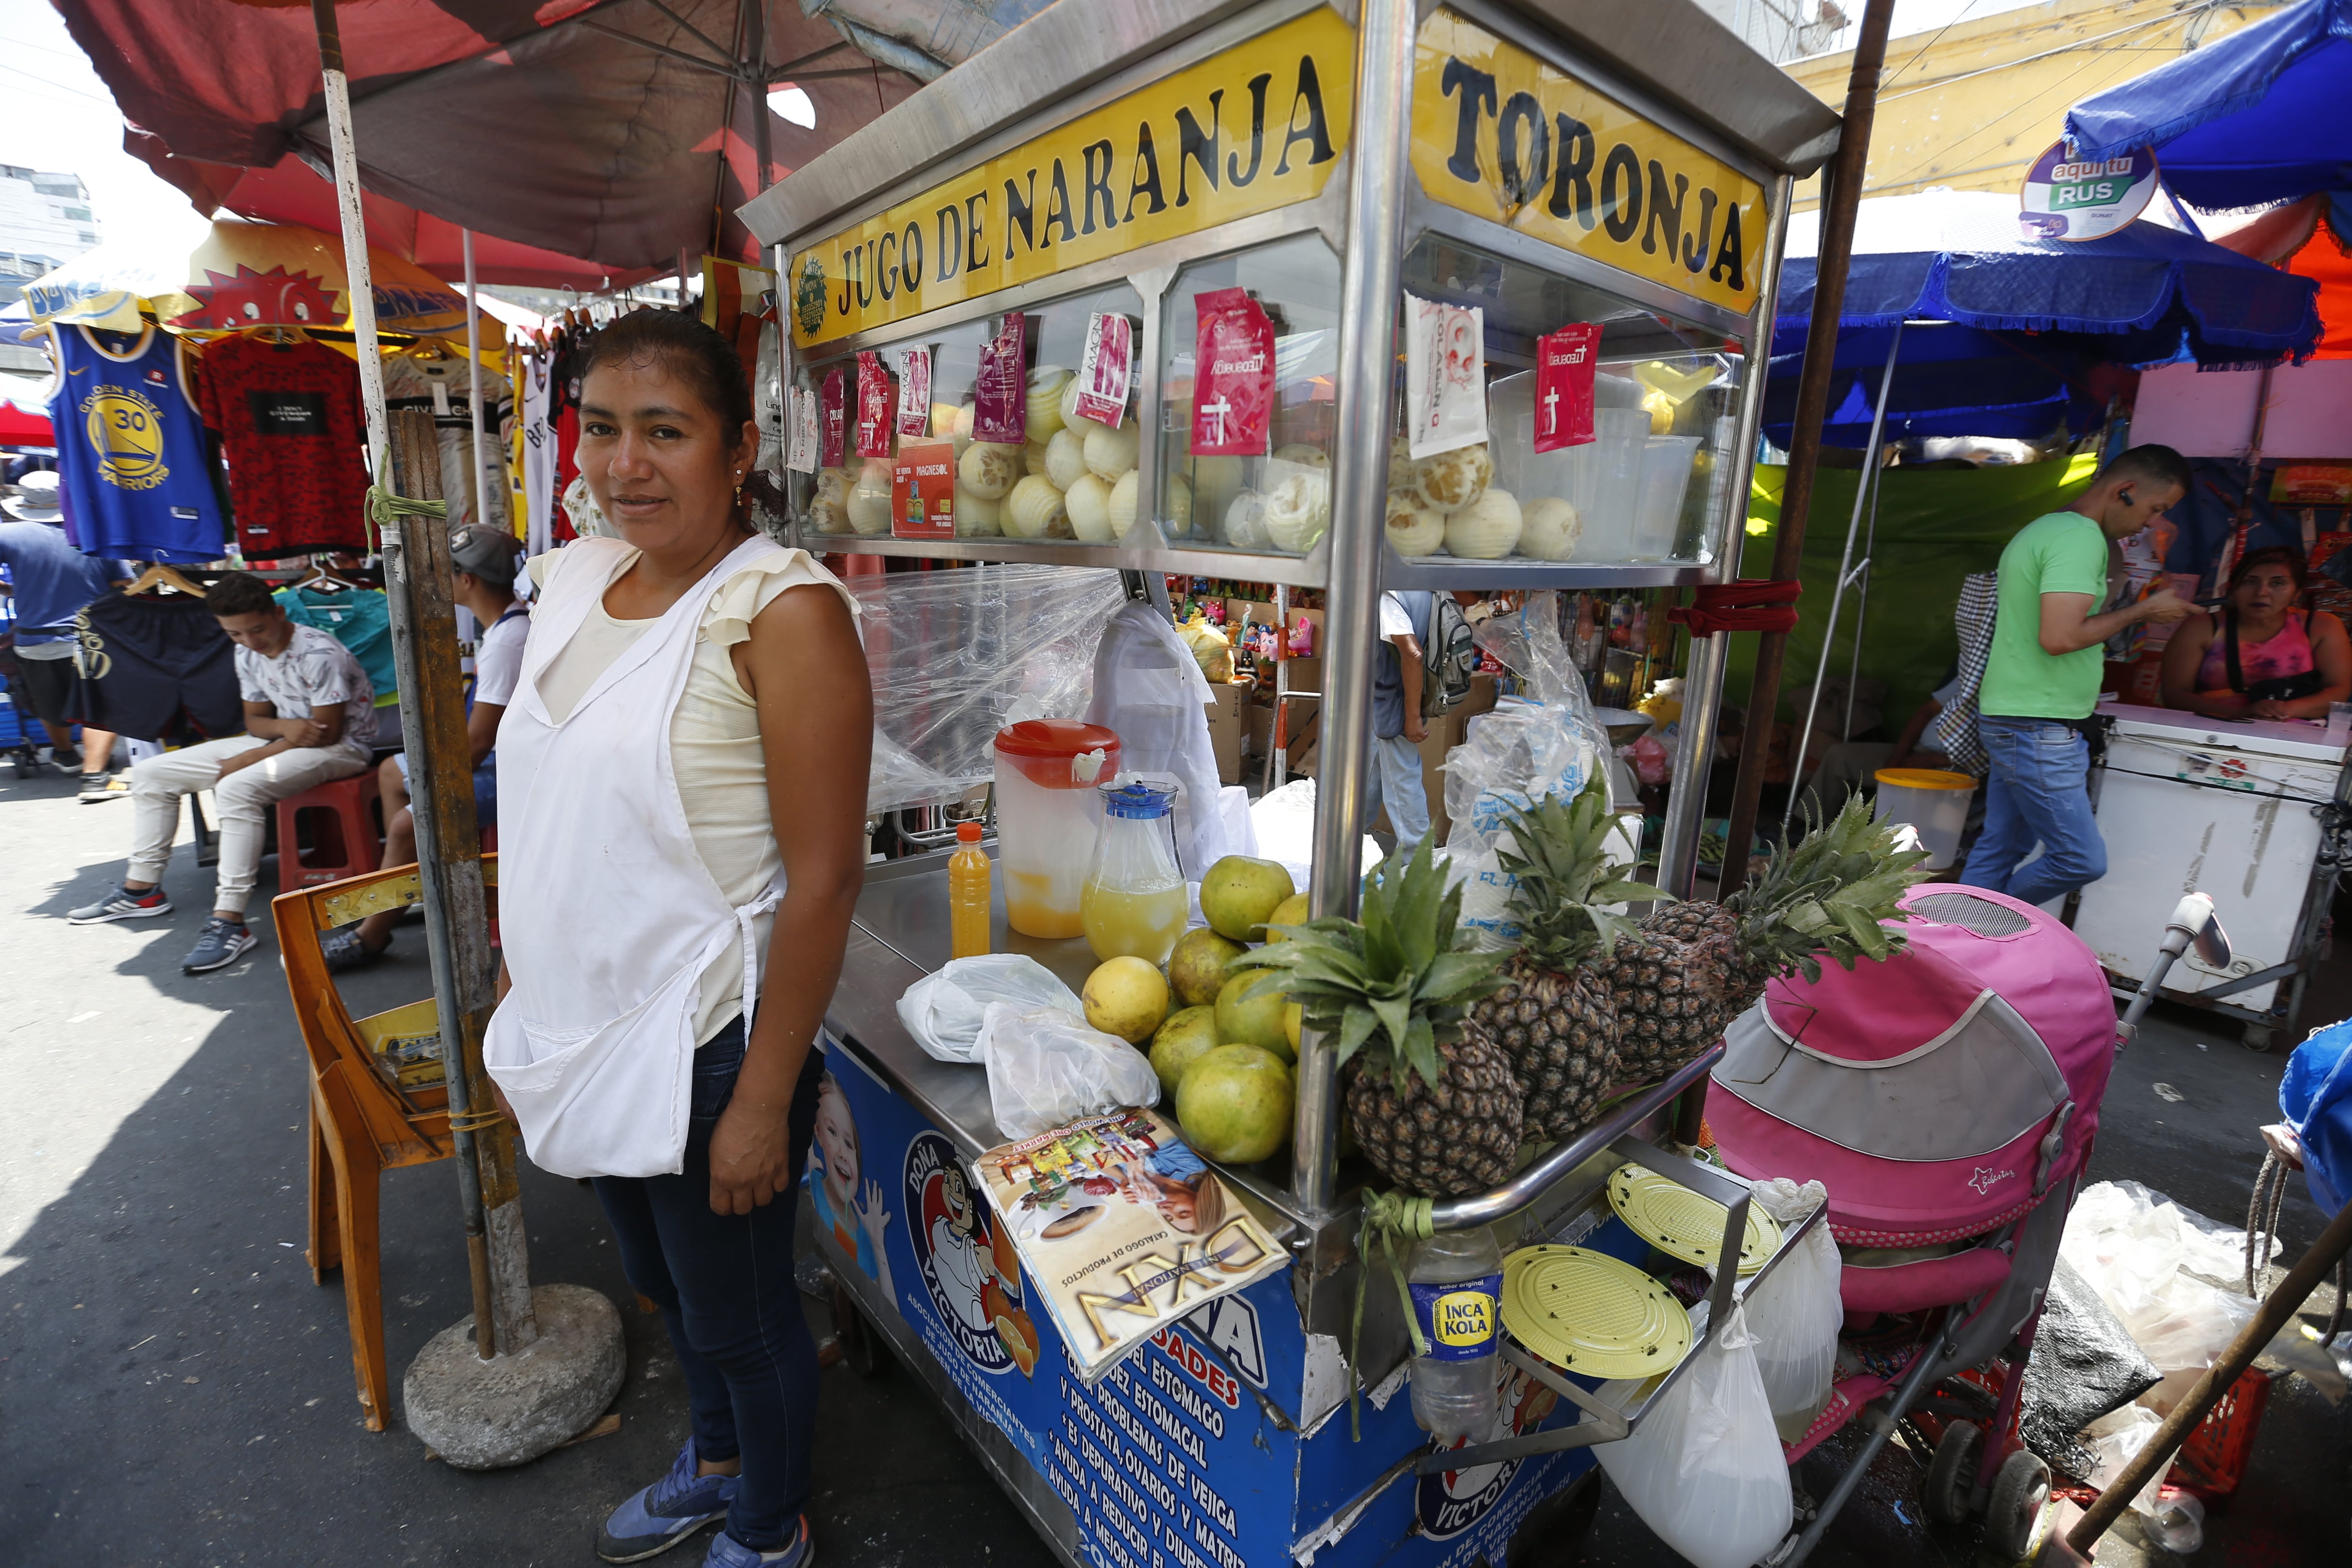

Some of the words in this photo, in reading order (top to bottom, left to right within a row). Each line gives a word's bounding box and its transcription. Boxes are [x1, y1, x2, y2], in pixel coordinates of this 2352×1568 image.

[837, 220, 922, 316] JUGO
[936, 189, 989, 283] DE
[1003, 54, 1336, 261] NARANJA
[1441, 55, 1746, 292] TORONJA
[2058, 182, 2113, 204] RUS
[2108, 157, 2130, 174] tu
[113, 408, 146, 432] 30
[916, 463, 948, 476] MAGNESOL
[1013, 1134, 1050, 1153] MARKET
[1052, 1128, 1072, 1138] ONE
[1072, 1118, 1106, 1131] WORLD
[1106, 1114, 1126, 1123] ONE
[909, 1142, 940, 1195] DOÑA
[1062, 1254, 1112, 1289] PRODUCTOS
[1113, 1250, 1125, 1262] DE
[1125, 1231, 1168, 1253] CATÁLOGO
[922, 1257, 1006, 1363] VICTORIA
[1077, 1215, 1285, 1352] DXN
[1445, 1303, 1484, 1320] INCA
[1459, 1279, 1484, 1289] original
[1445, 1319, 1488, 1337] KOLA
[907, 1292, 954, 1353] ASOCIACIÓN
[955, 1348, 965, 1366] DE
[967, 1362, 1035, 1449] COMERCIANTES
[922, 1334, 951, 1375] VIRGEN
[952, 1372, 962, 1390] DE
[964, 1385, 975, 1405] LA
[926, 1325, 936, 1343] DE
[937, 1342, 958, 1369] JUGO
[960, 1369, 970, 1386] DE
[972, 1384, 1014, 1437] NARANJA
[1152, 1357, 1224, 1439] ESTOMAGO
[1061, 1375, 1067, 1399] Y
[1071, 1387, 1123, 1465] PROSTATA,
[1125, 1449, 1176, 1516] OVARIOS
[1181, 1503, 1191, 1529] Y
[1135, 1381, 1207, 1469] ESTOMACAL
[1098, 1382, 1162, 1465] PROBLEMAS
[1168, 1455, 1185, 1488] DE
[1192, 1473, 1236, 1538] VEJIGA
[1049, 1466, 1081, 1516] AYUDA
[1084, 1505, 1092, 1530] A
[1055, 1437, 1087, 1491] AYUDA
[1090, 1481, 1098, 1505] A
[1103, 1492, 1148, 1561] REDUCIR
[1068, 1418, 1079, 1446] ES
[1081, 1435, 1147, 1523] DEPURATIVO
[1152, 1511, 1161, 1537] Y
[1166, 1526, 1209, 1568] DIURE
[1455, 1534, 1474, 1559] DE
[1478, 1449, 1566, 1537] COMERCIANTE
[1463, 1542, 1481, 1566] DE
[1485, 1482, 1542, 1545] NARANJA
[1489, 1490, 1545, 1552] VICTORIA
[725, 1547, 747, 1561] Reebok
